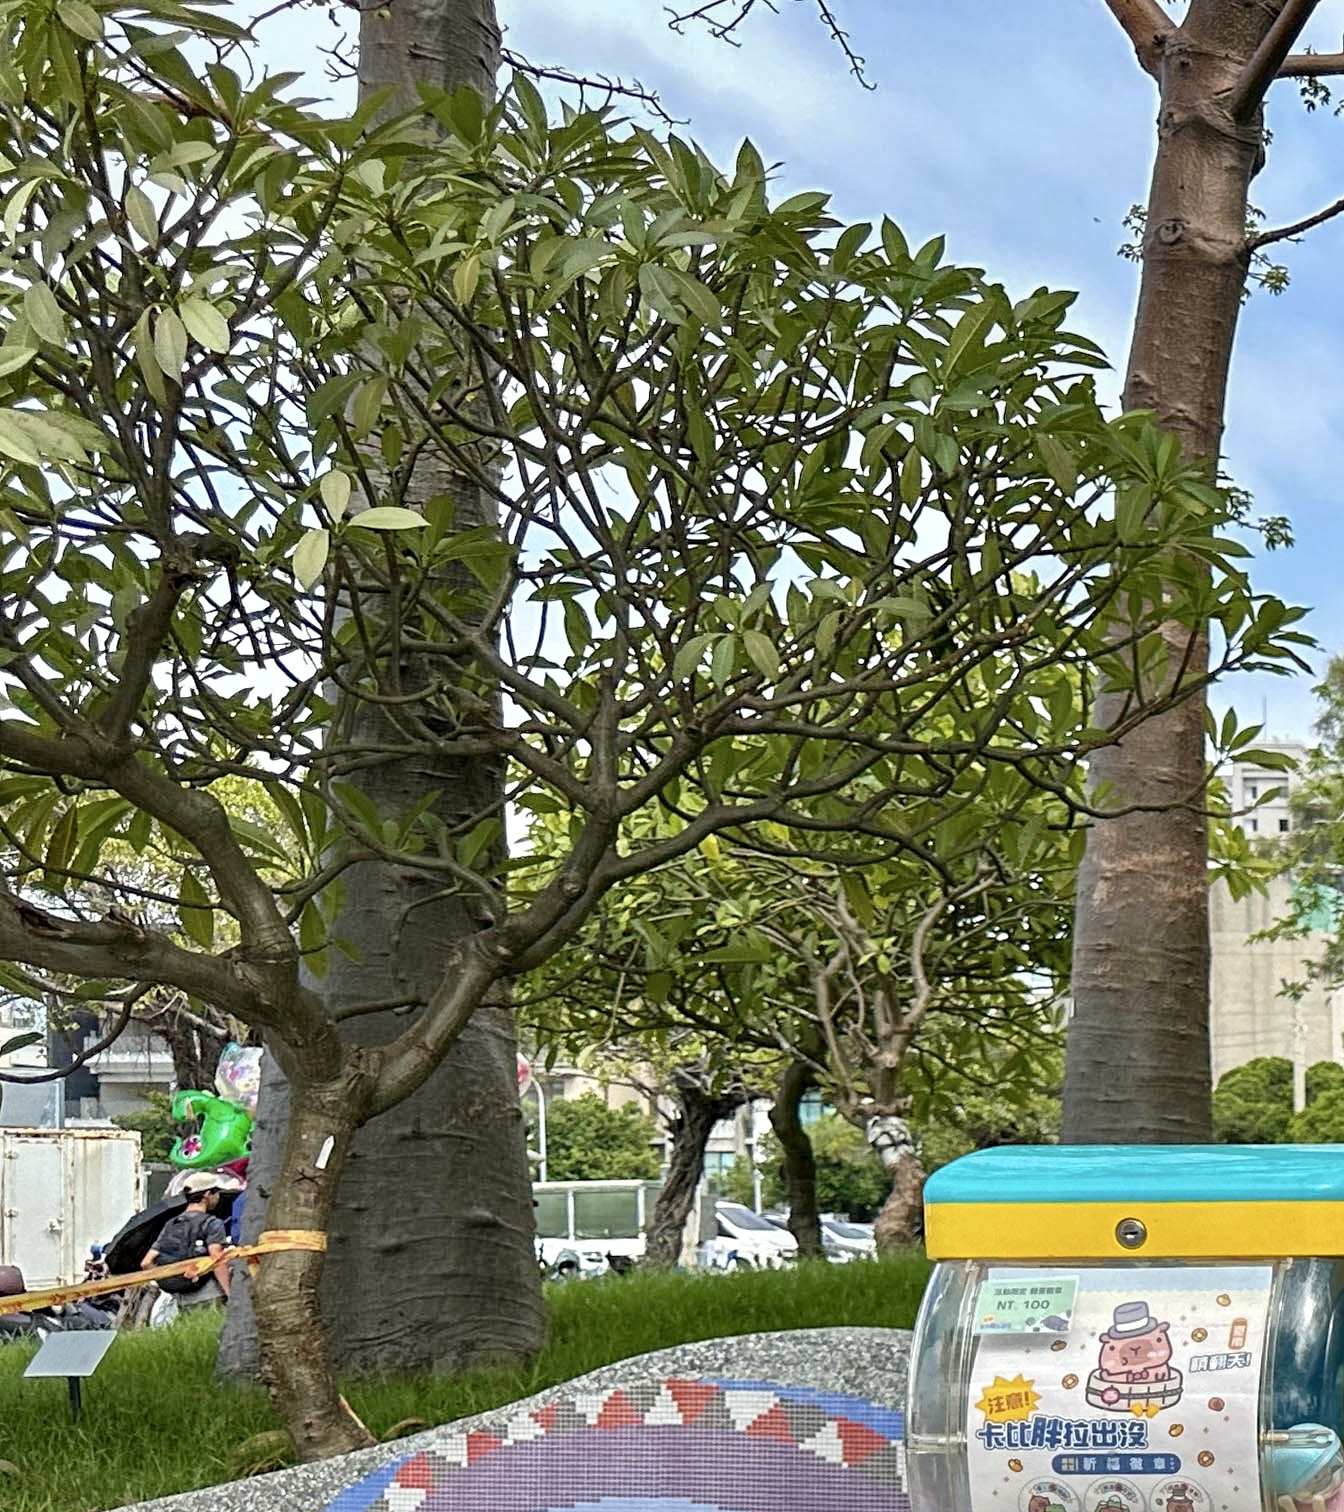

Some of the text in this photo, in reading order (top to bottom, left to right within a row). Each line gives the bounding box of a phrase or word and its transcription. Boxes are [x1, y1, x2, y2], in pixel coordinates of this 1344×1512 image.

[1024, 1299, 1049, 1310] 100
[987, 1390, 1031, 1414] 注意!
[976, 1413, 1148, 1450] 卡比胖拉出沒
